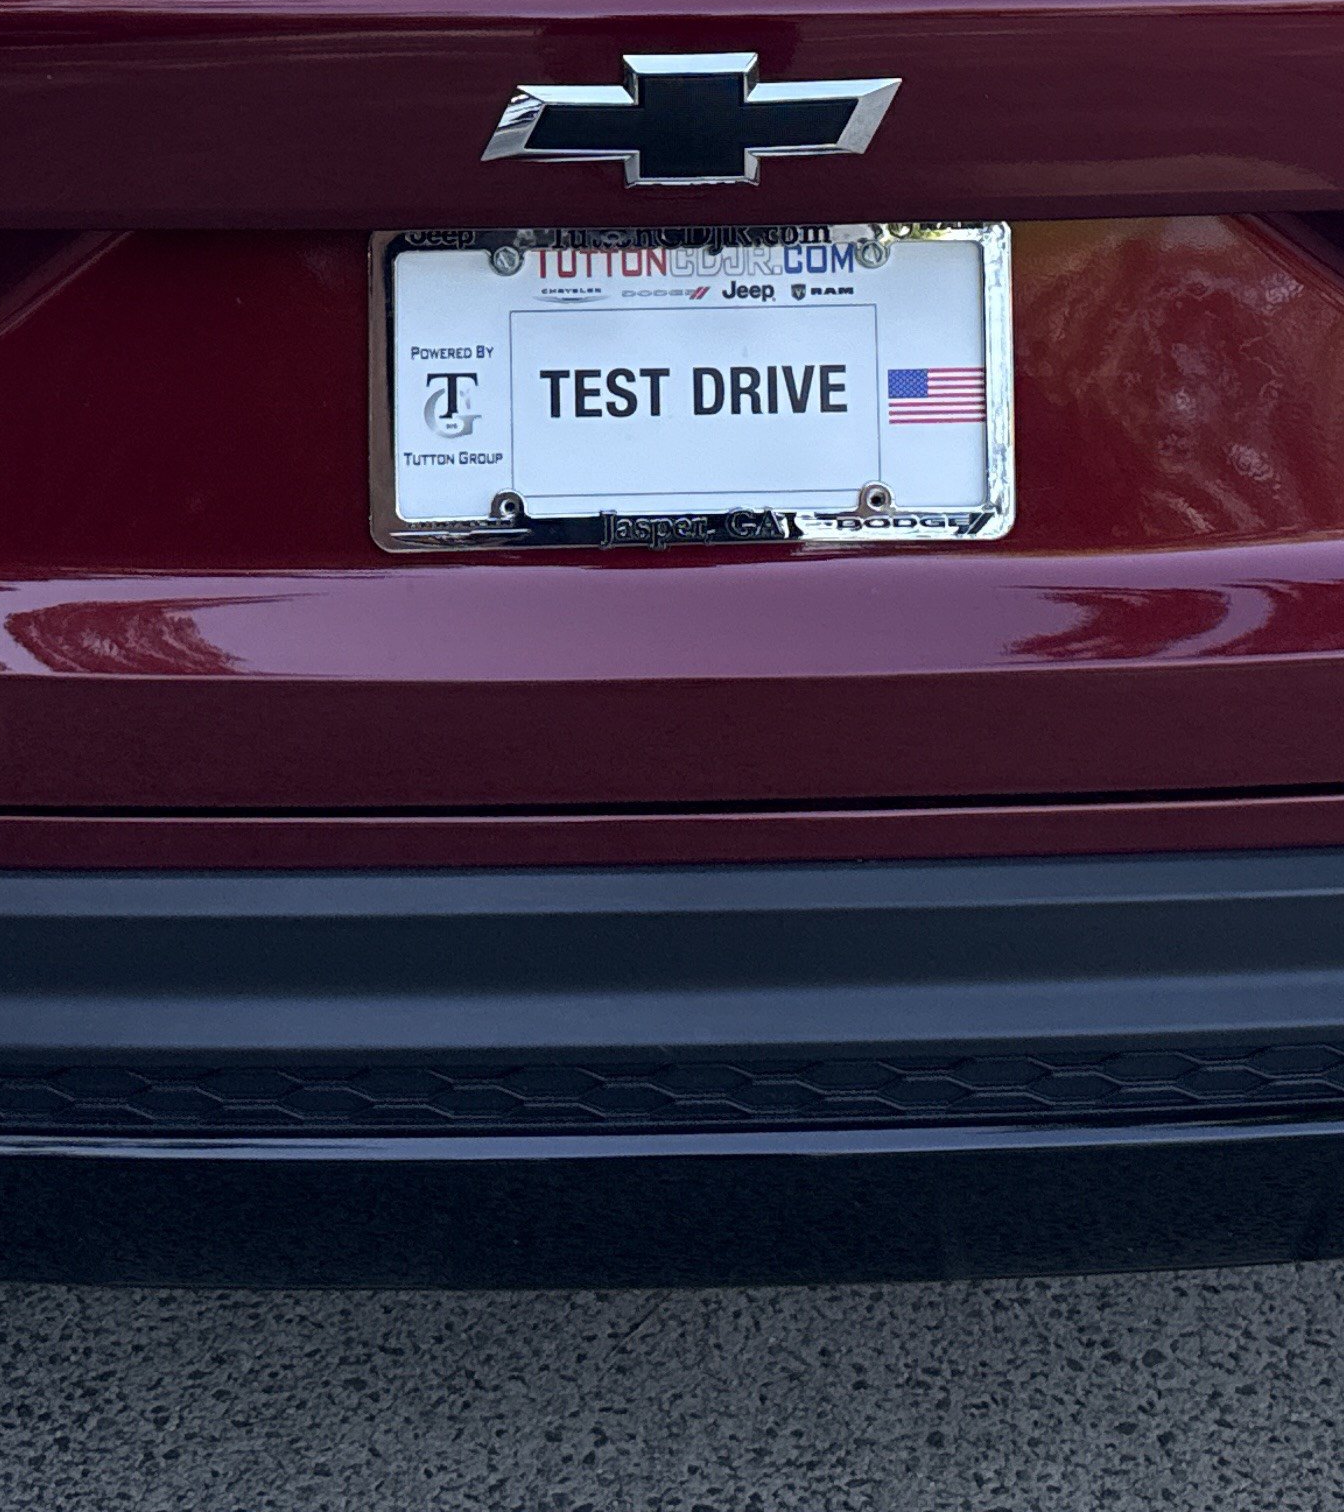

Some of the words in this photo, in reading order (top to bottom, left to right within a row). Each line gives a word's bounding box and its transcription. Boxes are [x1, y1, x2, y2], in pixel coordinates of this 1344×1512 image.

[532, 242, 854, 279] TUTTONCDJR.COM
[541, 287, 602, 295] CHRYSLER
[722, 281, 775, 302] Jeep
[811, 287, 854, 295] RAM
[540, 367, 671, 419] TEST
[692, 364, 848, 416] DRIVE
